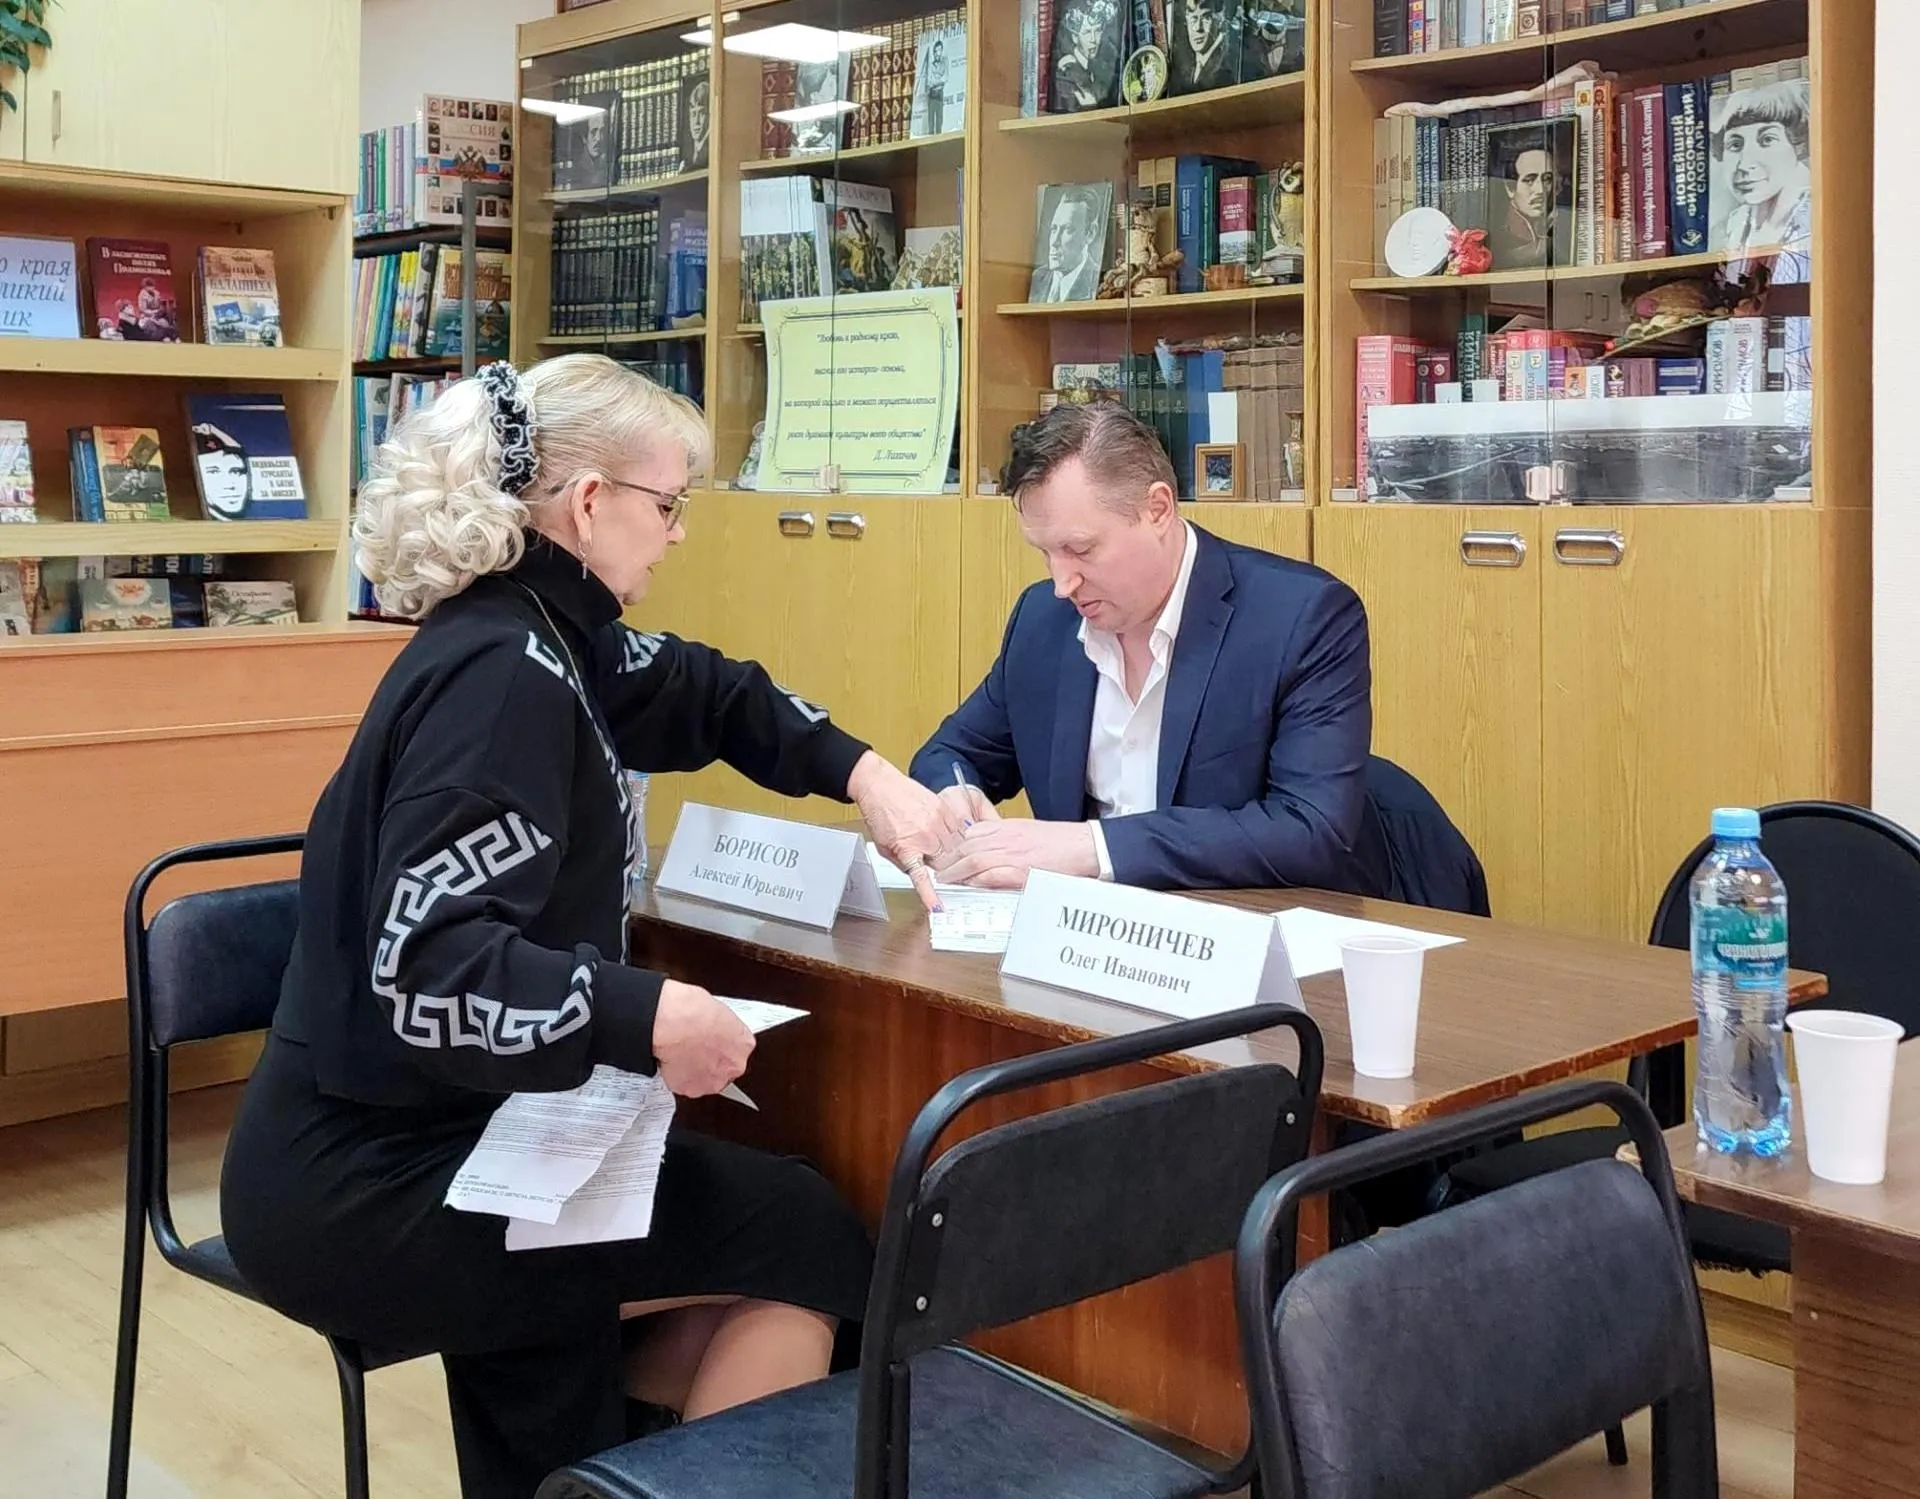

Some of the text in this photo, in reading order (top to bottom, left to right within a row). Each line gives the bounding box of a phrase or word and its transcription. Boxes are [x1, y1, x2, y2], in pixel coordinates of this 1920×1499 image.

[1670, 115, 1686, 206] НОВЕЙШИЙ
[1681, 92, 1697, 217] ФИЛОСОФСКИЙ
[1694, 120, 1706, 193] СЛОВАРЬ
[1642, 168, 1653, 197] России
[19, 260, 71, 280] края
[714, 833, 800, 869] БОРИСОВ
[689, 864, 804, 902] Алексей Юрьевич
[1057, 905, 1216, 962] МИРОНИЧЕВ
[1059, 946, 1192, 995] Олег Иванович
